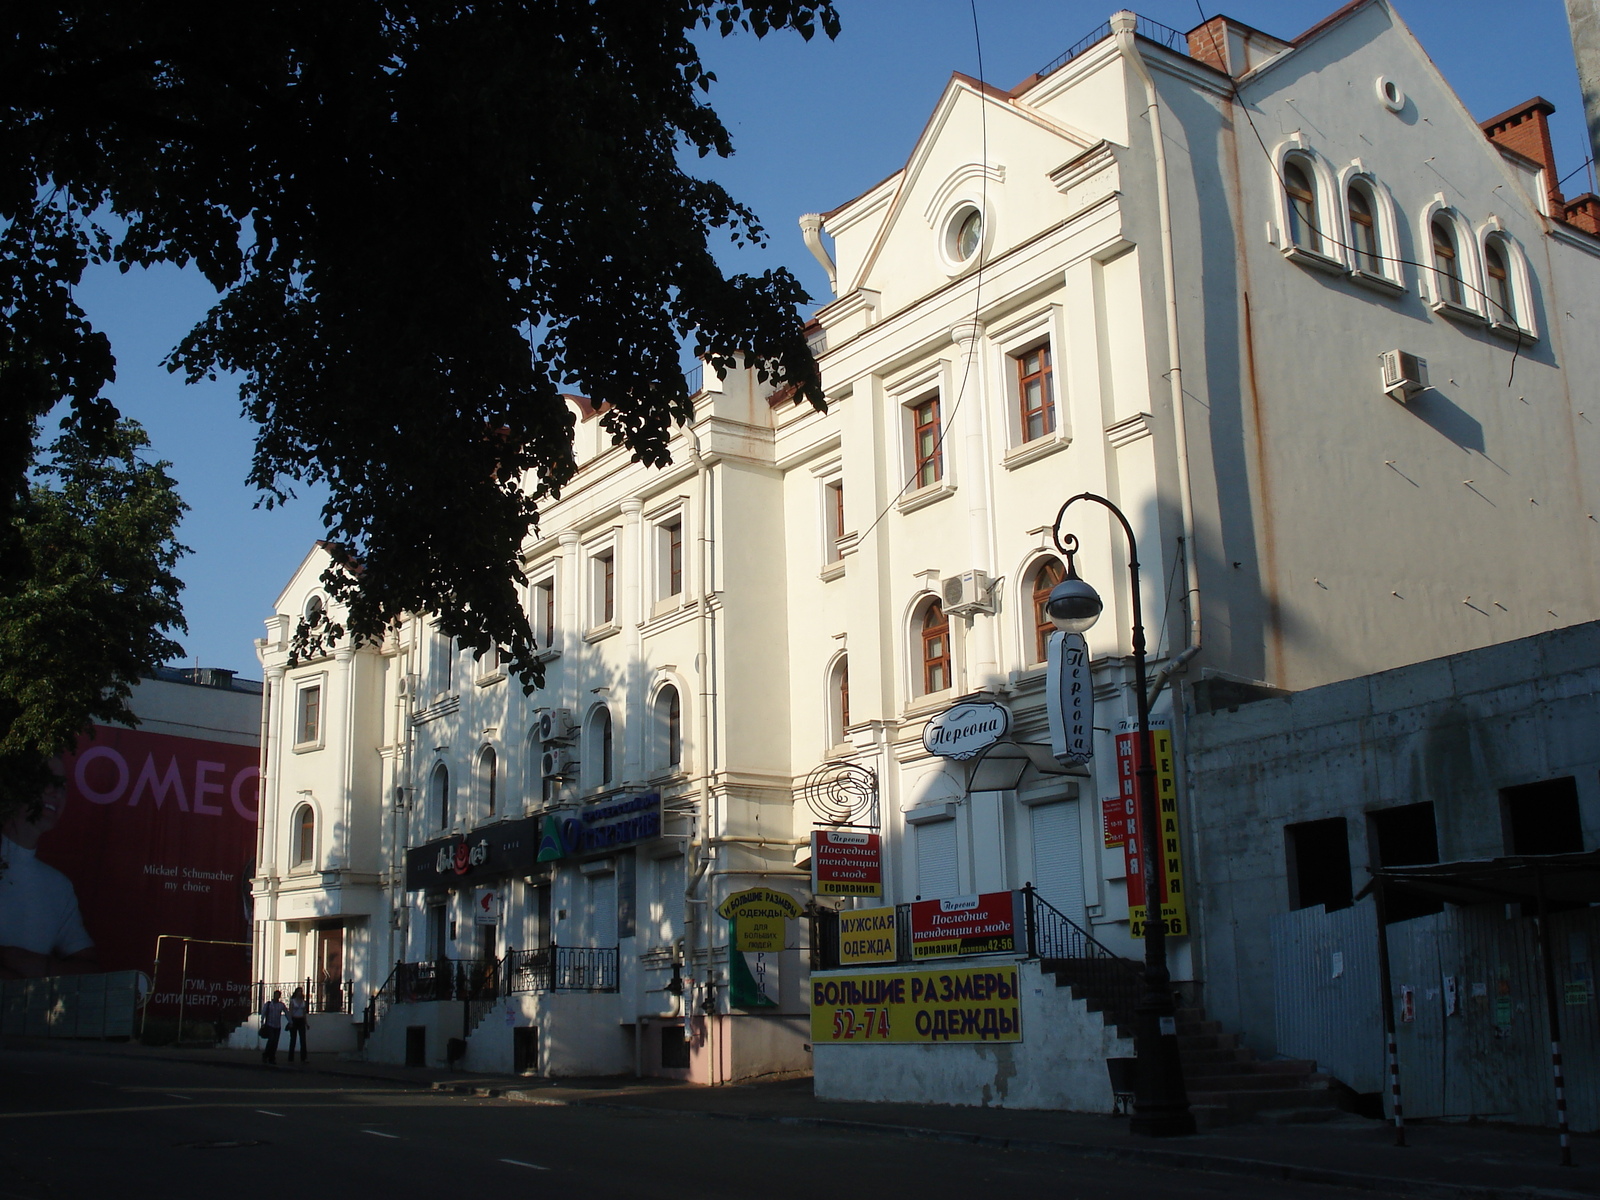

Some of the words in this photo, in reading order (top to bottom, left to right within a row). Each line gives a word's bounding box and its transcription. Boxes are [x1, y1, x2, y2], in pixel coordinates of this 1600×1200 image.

[1066, 648, 1084, 749] Персона
[931, 719, 997, 745] Персона
[1118, 720, 1165, 729] Перна
[1119, 740, 1138, 874] ЖЕНСКАЯ
[1159, 739, 1180, 893] ГЕРМАНИЯ
[831, 834, 865, 843] Персона
[819, 845, 877, 856] Последние
[818, 857, 879, 869] тенденции
[143, 864, 178, 877] Mickael
[182, 867, 234, 882] Schumacher
[840, 870, 867, 879] моде
[164, 881, 178, 891] my
[182, 880, 211, 893] choice
[824, 883, 875, 893] германия
[724, 906, 731, 916] И
[730, 892, 763, 910] БОЛЬШИЕ
[766, 893, 797, 917] РАЗМЕРЫ
[739, 908, 782, 918] ОДЕЖДЫ
[944, 901, 976, 910] Персона
[841, 915, 895, 933] МУЖСКАЯ
[932, 911, 989, 925] Последние
[914, 925, 973, 940] тенденции
[983, 920, 1011, 933] моде
[844, 938, 892, 957] ОДЕЖДА
[914, 943, 958, 956] германия
[988, 938, 1012, 951] 42-56
[813, 979, 905, 1006] БОЛЬШИЕ
[911, 972, 1018, 1004] РАЗМЕРЫ
[832, 1008, 890, 1040] 52-74
[915, 1007, 1019, 1041] ОДЕЖДЫ
